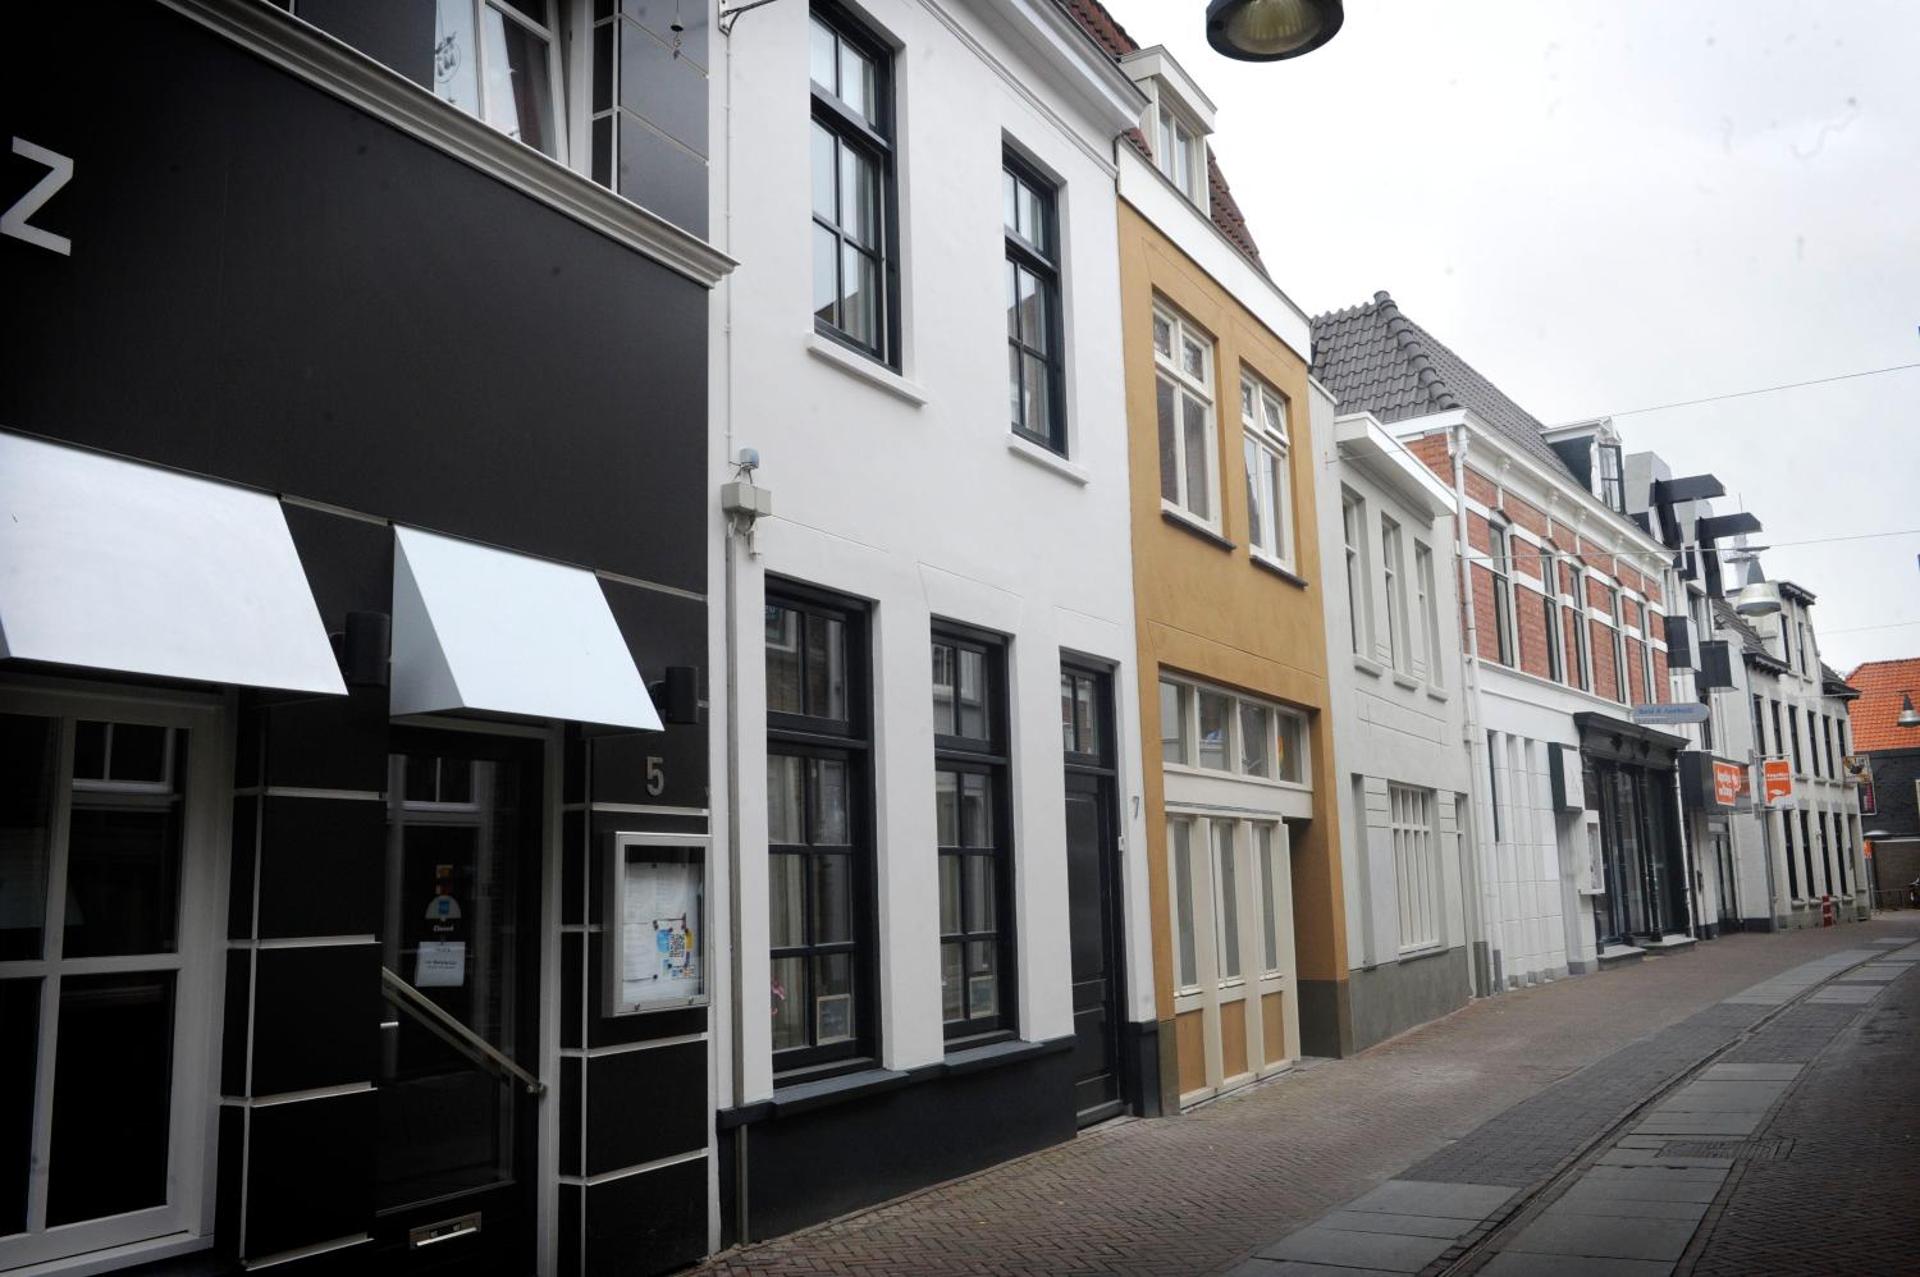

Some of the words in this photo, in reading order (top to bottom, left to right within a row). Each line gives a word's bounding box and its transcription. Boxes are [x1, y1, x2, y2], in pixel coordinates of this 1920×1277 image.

[0, 136, 74, 256] Z
[647, 756, 664, 796] 5
[1132, 796, 1140, 820] 7
